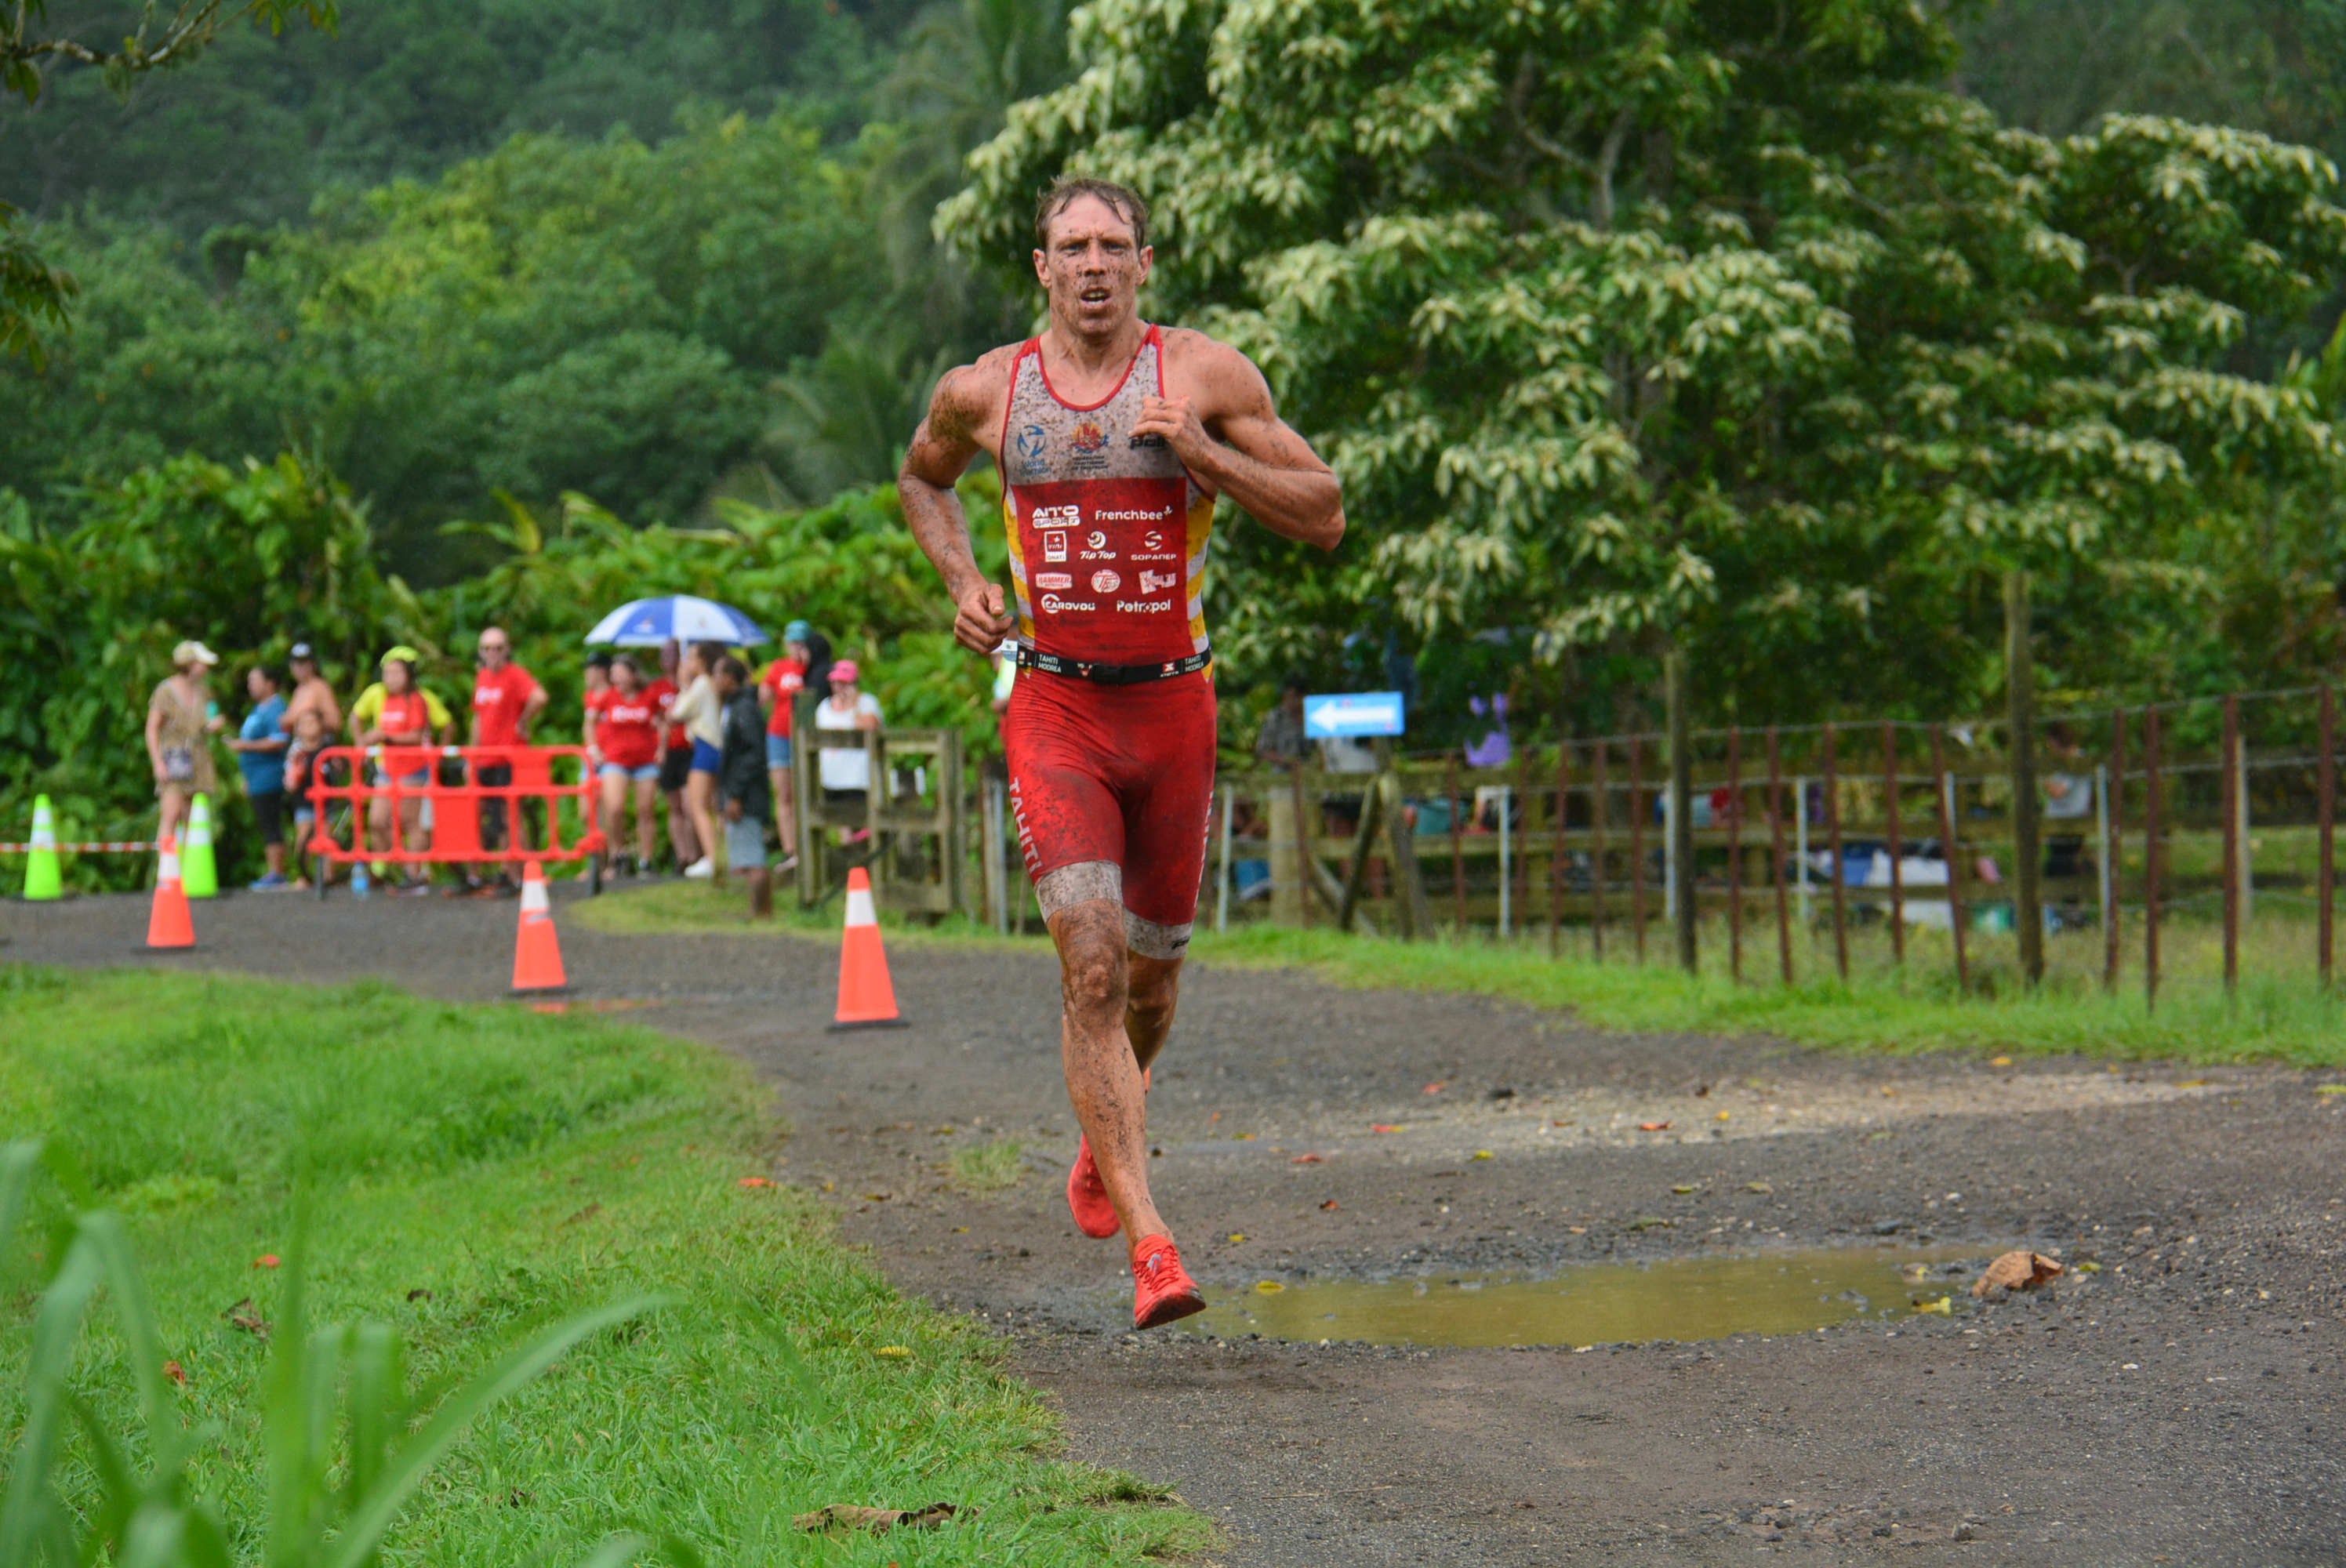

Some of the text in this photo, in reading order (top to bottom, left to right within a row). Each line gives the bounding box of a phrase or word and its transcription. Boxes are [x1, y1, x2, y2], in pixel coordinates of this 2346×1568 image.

[1032, 505, 1080, 518] AITO
[1095, 509, 1164, 521] Frenchbee
[1080, 550, 1117, 561] Tip Top
[1038, 575, 1071, 584] HAMMER
[1039, 653, 1059, 665] TAHITI
[1185, 654, 1201, 666] TAHITI
[1037, 662, 1062, 673] MOOREA
[1185, 661, 1204, 673] MOOREA
[1009, 775, 1043, 874] TAHITI
